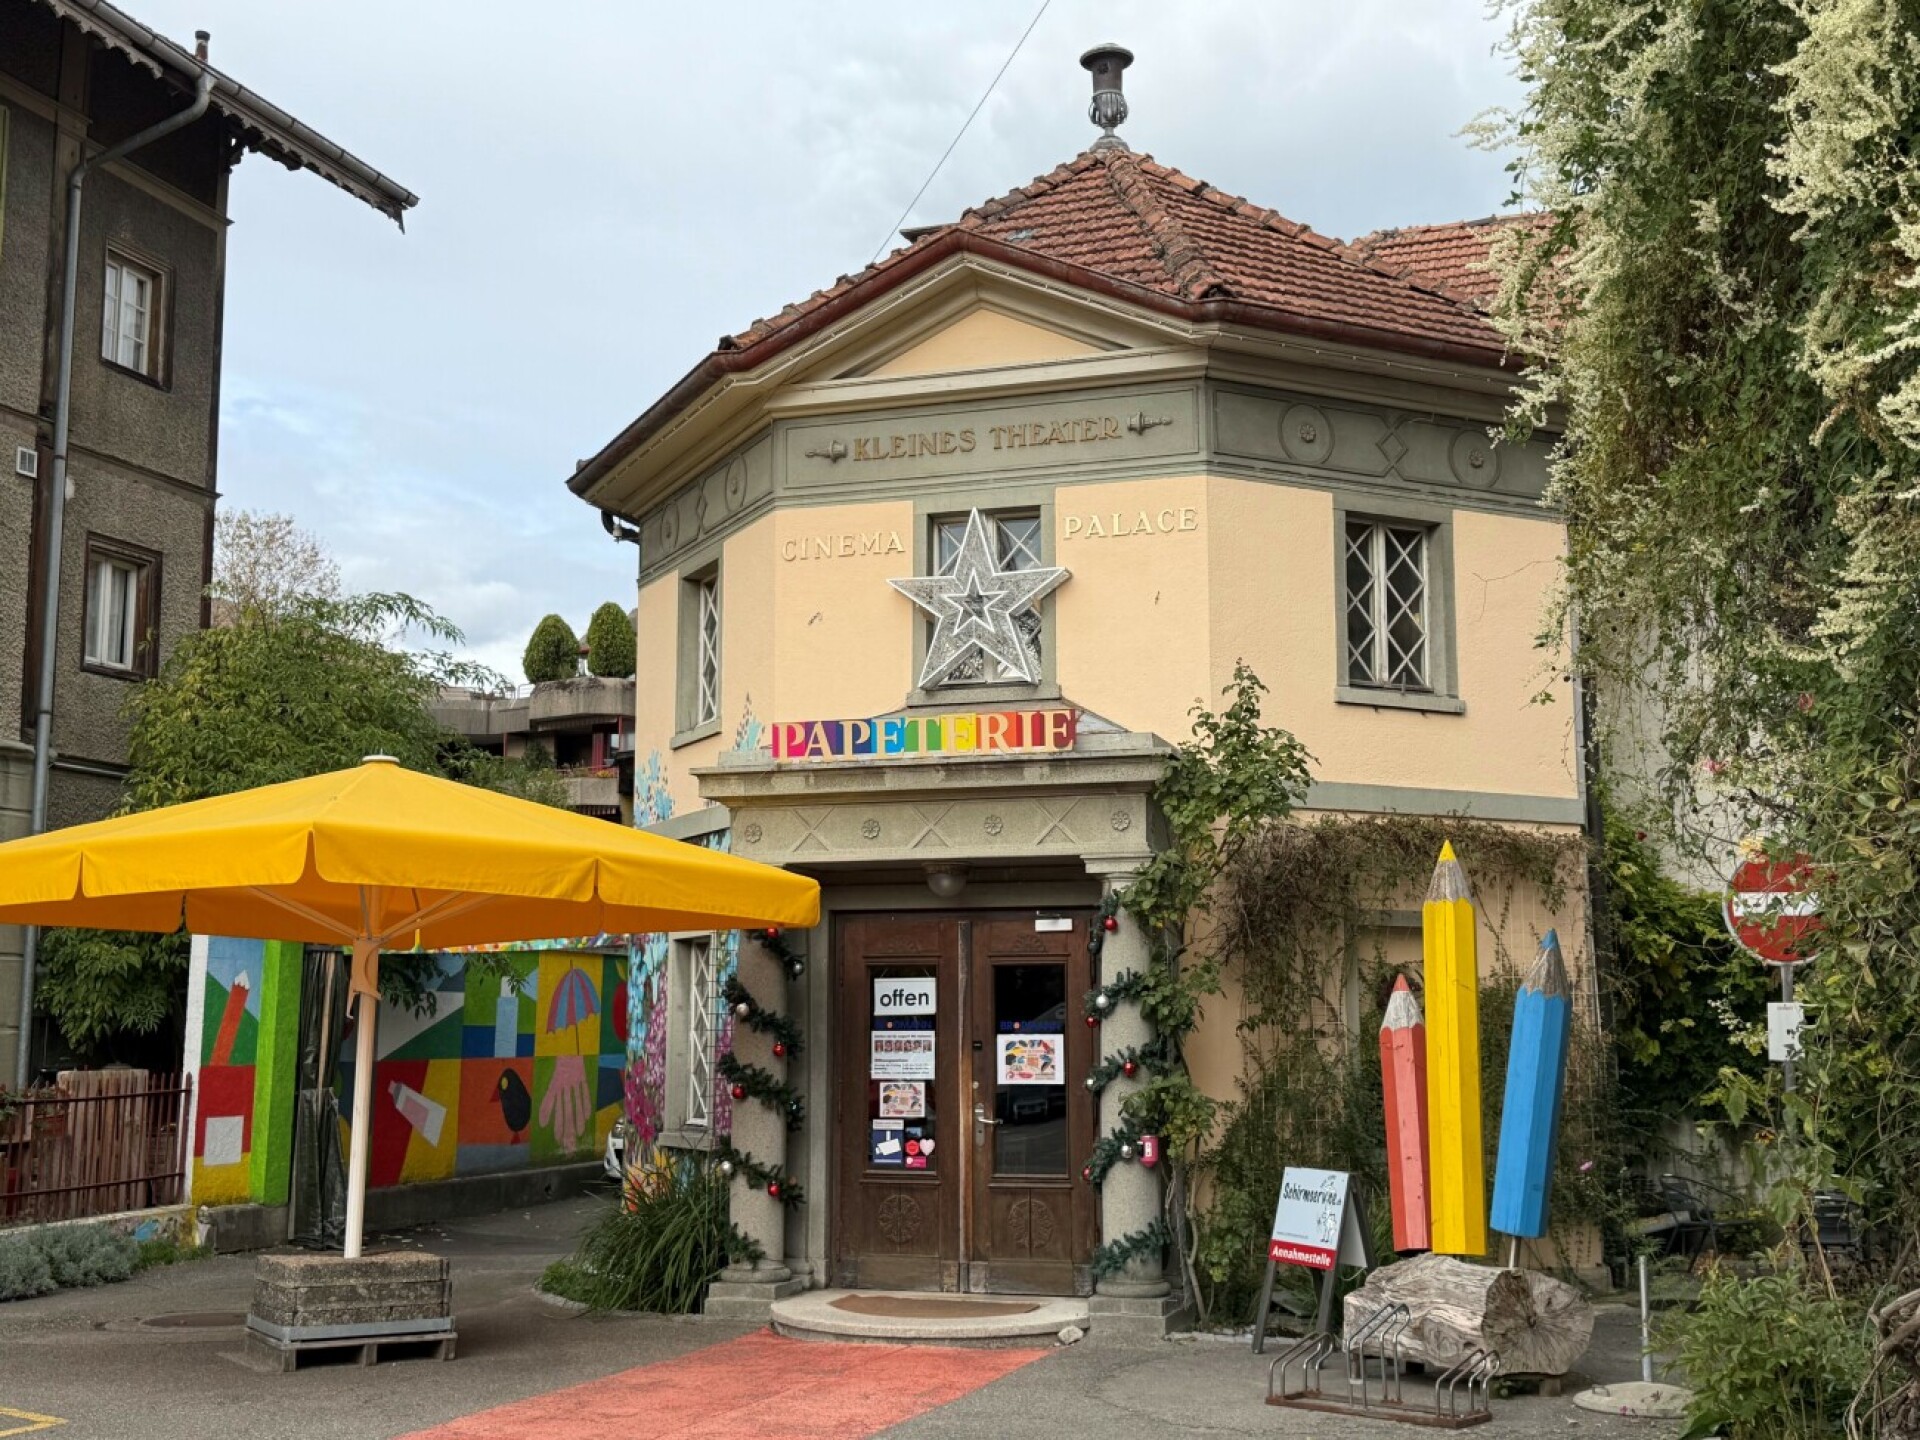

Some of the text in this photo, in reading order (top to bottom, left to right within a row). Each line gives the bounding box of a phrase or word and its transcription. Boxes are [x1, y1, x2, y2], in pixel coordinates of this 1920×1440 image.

[853, 416, 1122, 462] KLEINES THEATER
[781, 507, 1200, 562] CINEMA PALACE
[775, 709, 1074, 763] PAPETERIE
[879, 988, 930, 1007] offen
[1272, 1246, 1332, 1267] Annahmestelle
